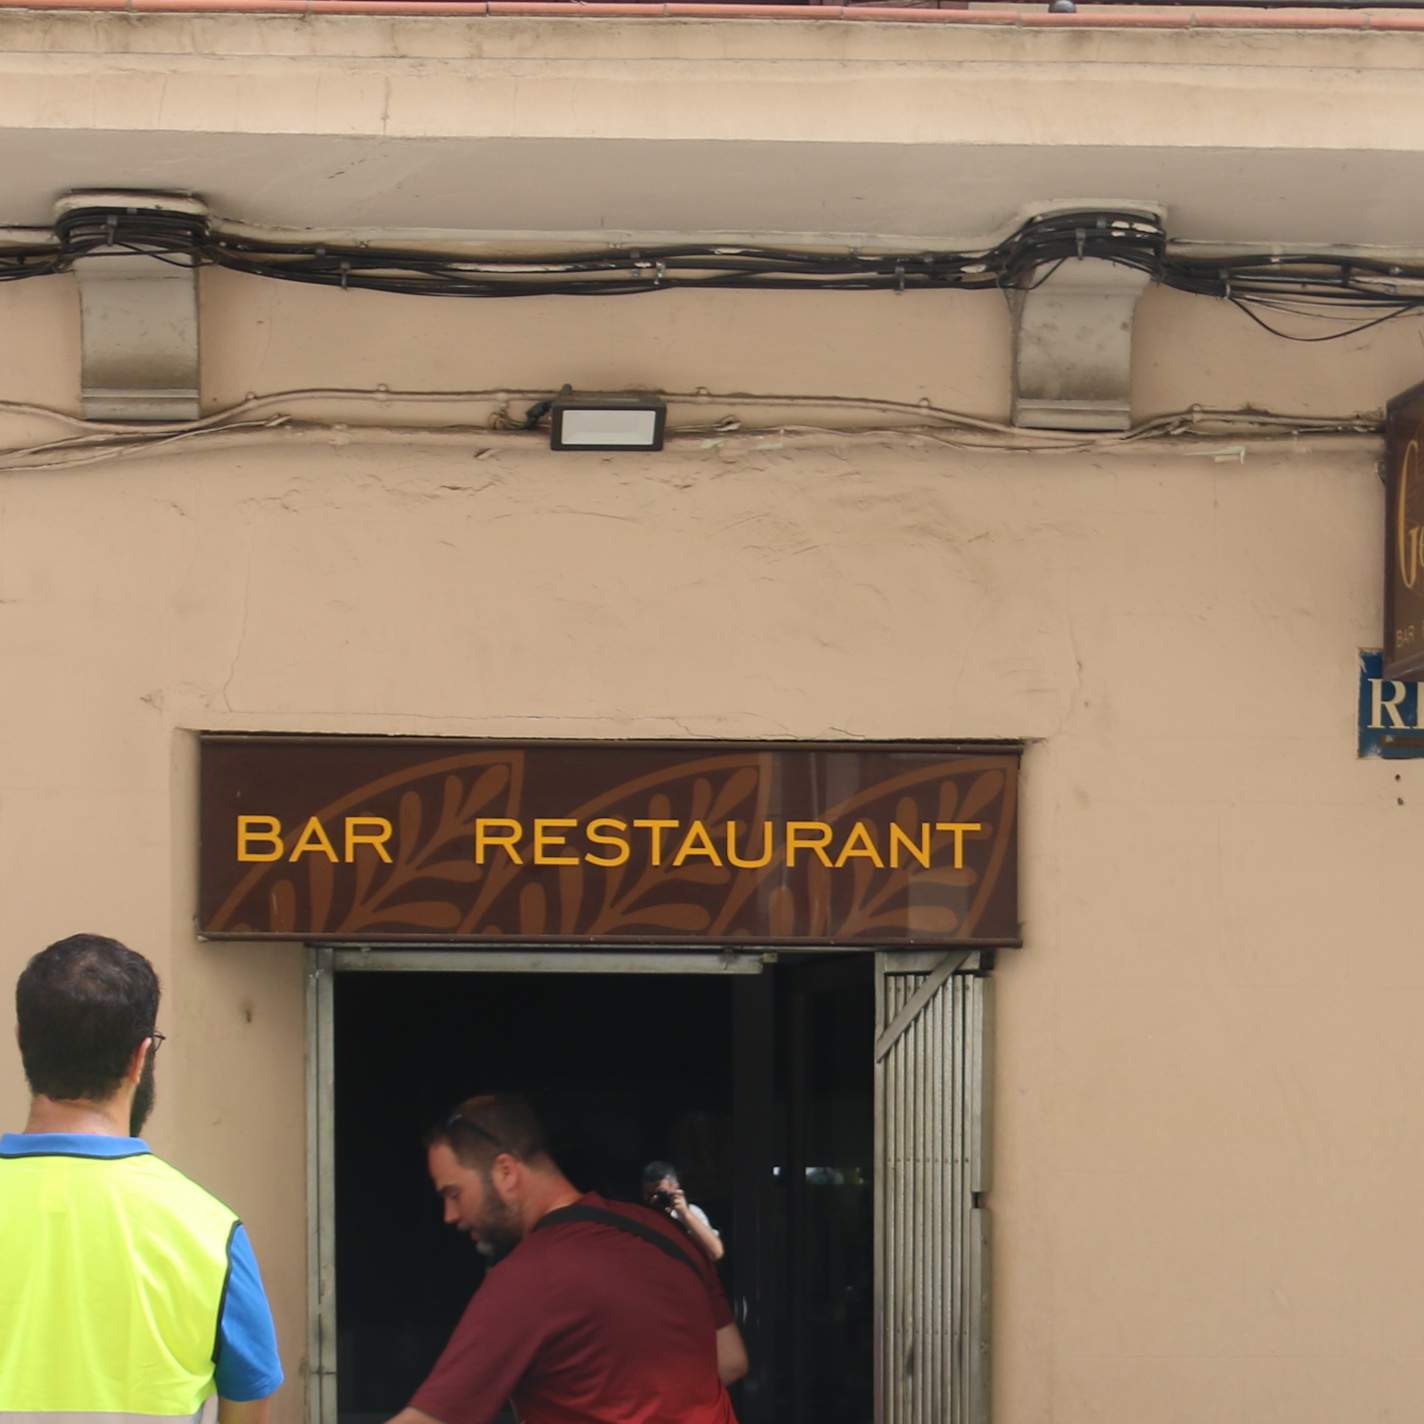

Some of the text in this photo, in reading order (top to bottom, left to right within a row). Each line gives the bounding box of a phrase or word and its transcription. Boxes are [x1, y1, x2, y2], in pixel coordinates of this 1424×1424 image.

[1396, 624, 1416, 649] BAR
[235, 814, 982, 870] BAR RESTAURANT
